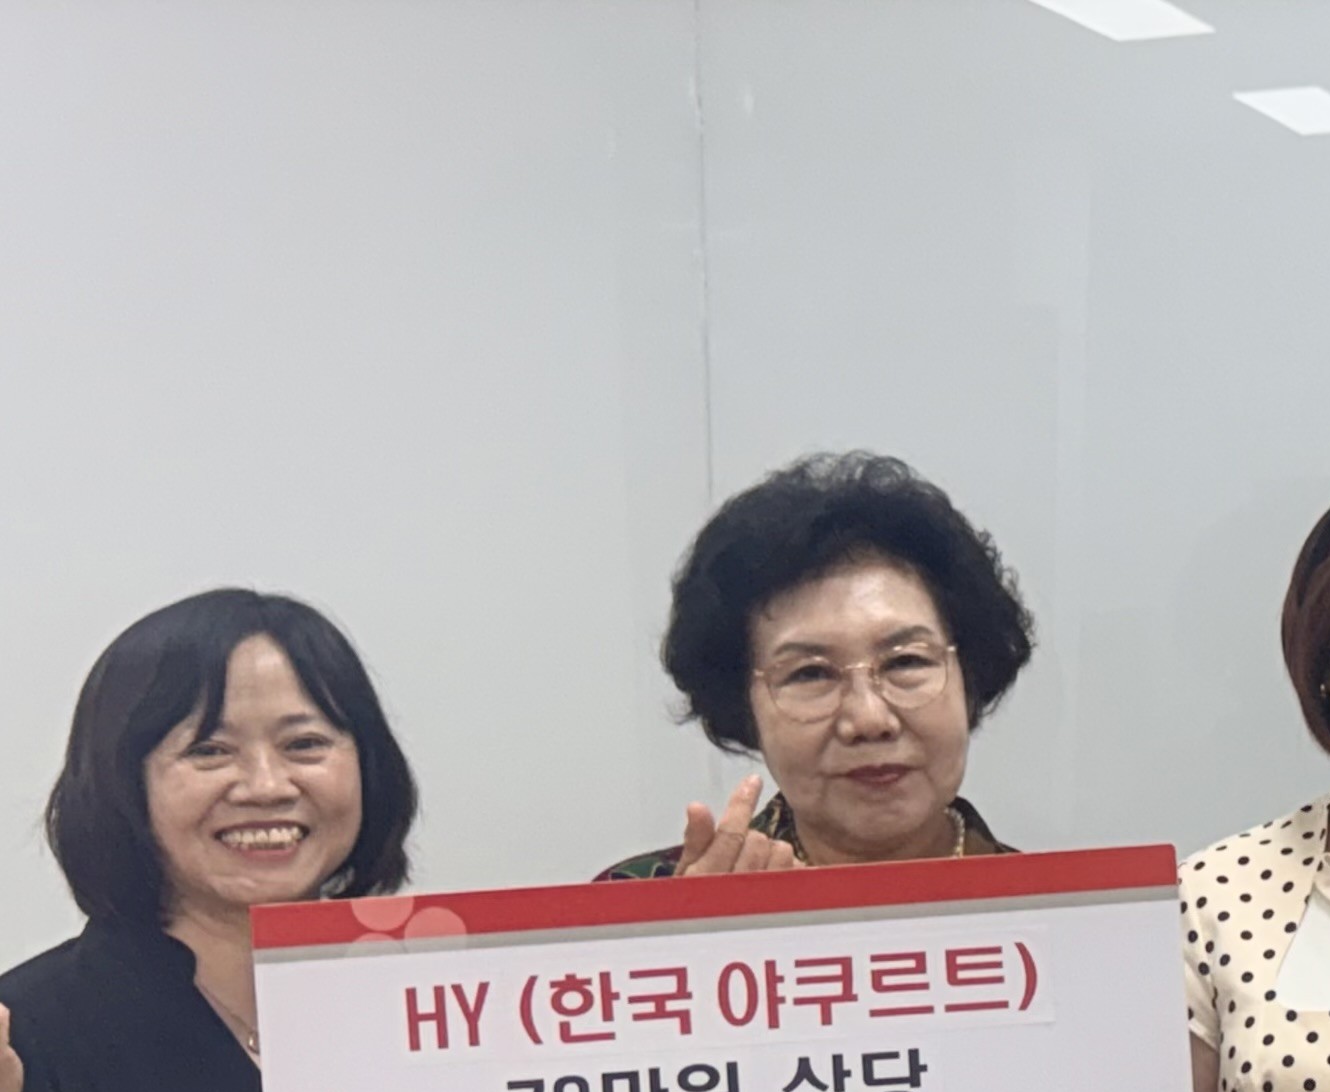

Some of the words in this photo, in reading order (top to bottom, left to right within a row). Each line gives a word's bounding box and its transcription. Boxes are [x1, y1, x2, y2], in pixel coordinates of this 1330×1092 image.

[405, 981, 490, 1052] HY
[520, 969, 694, 1046] (한국
[718, 943, 1039, 1031] 야쿠르트)
